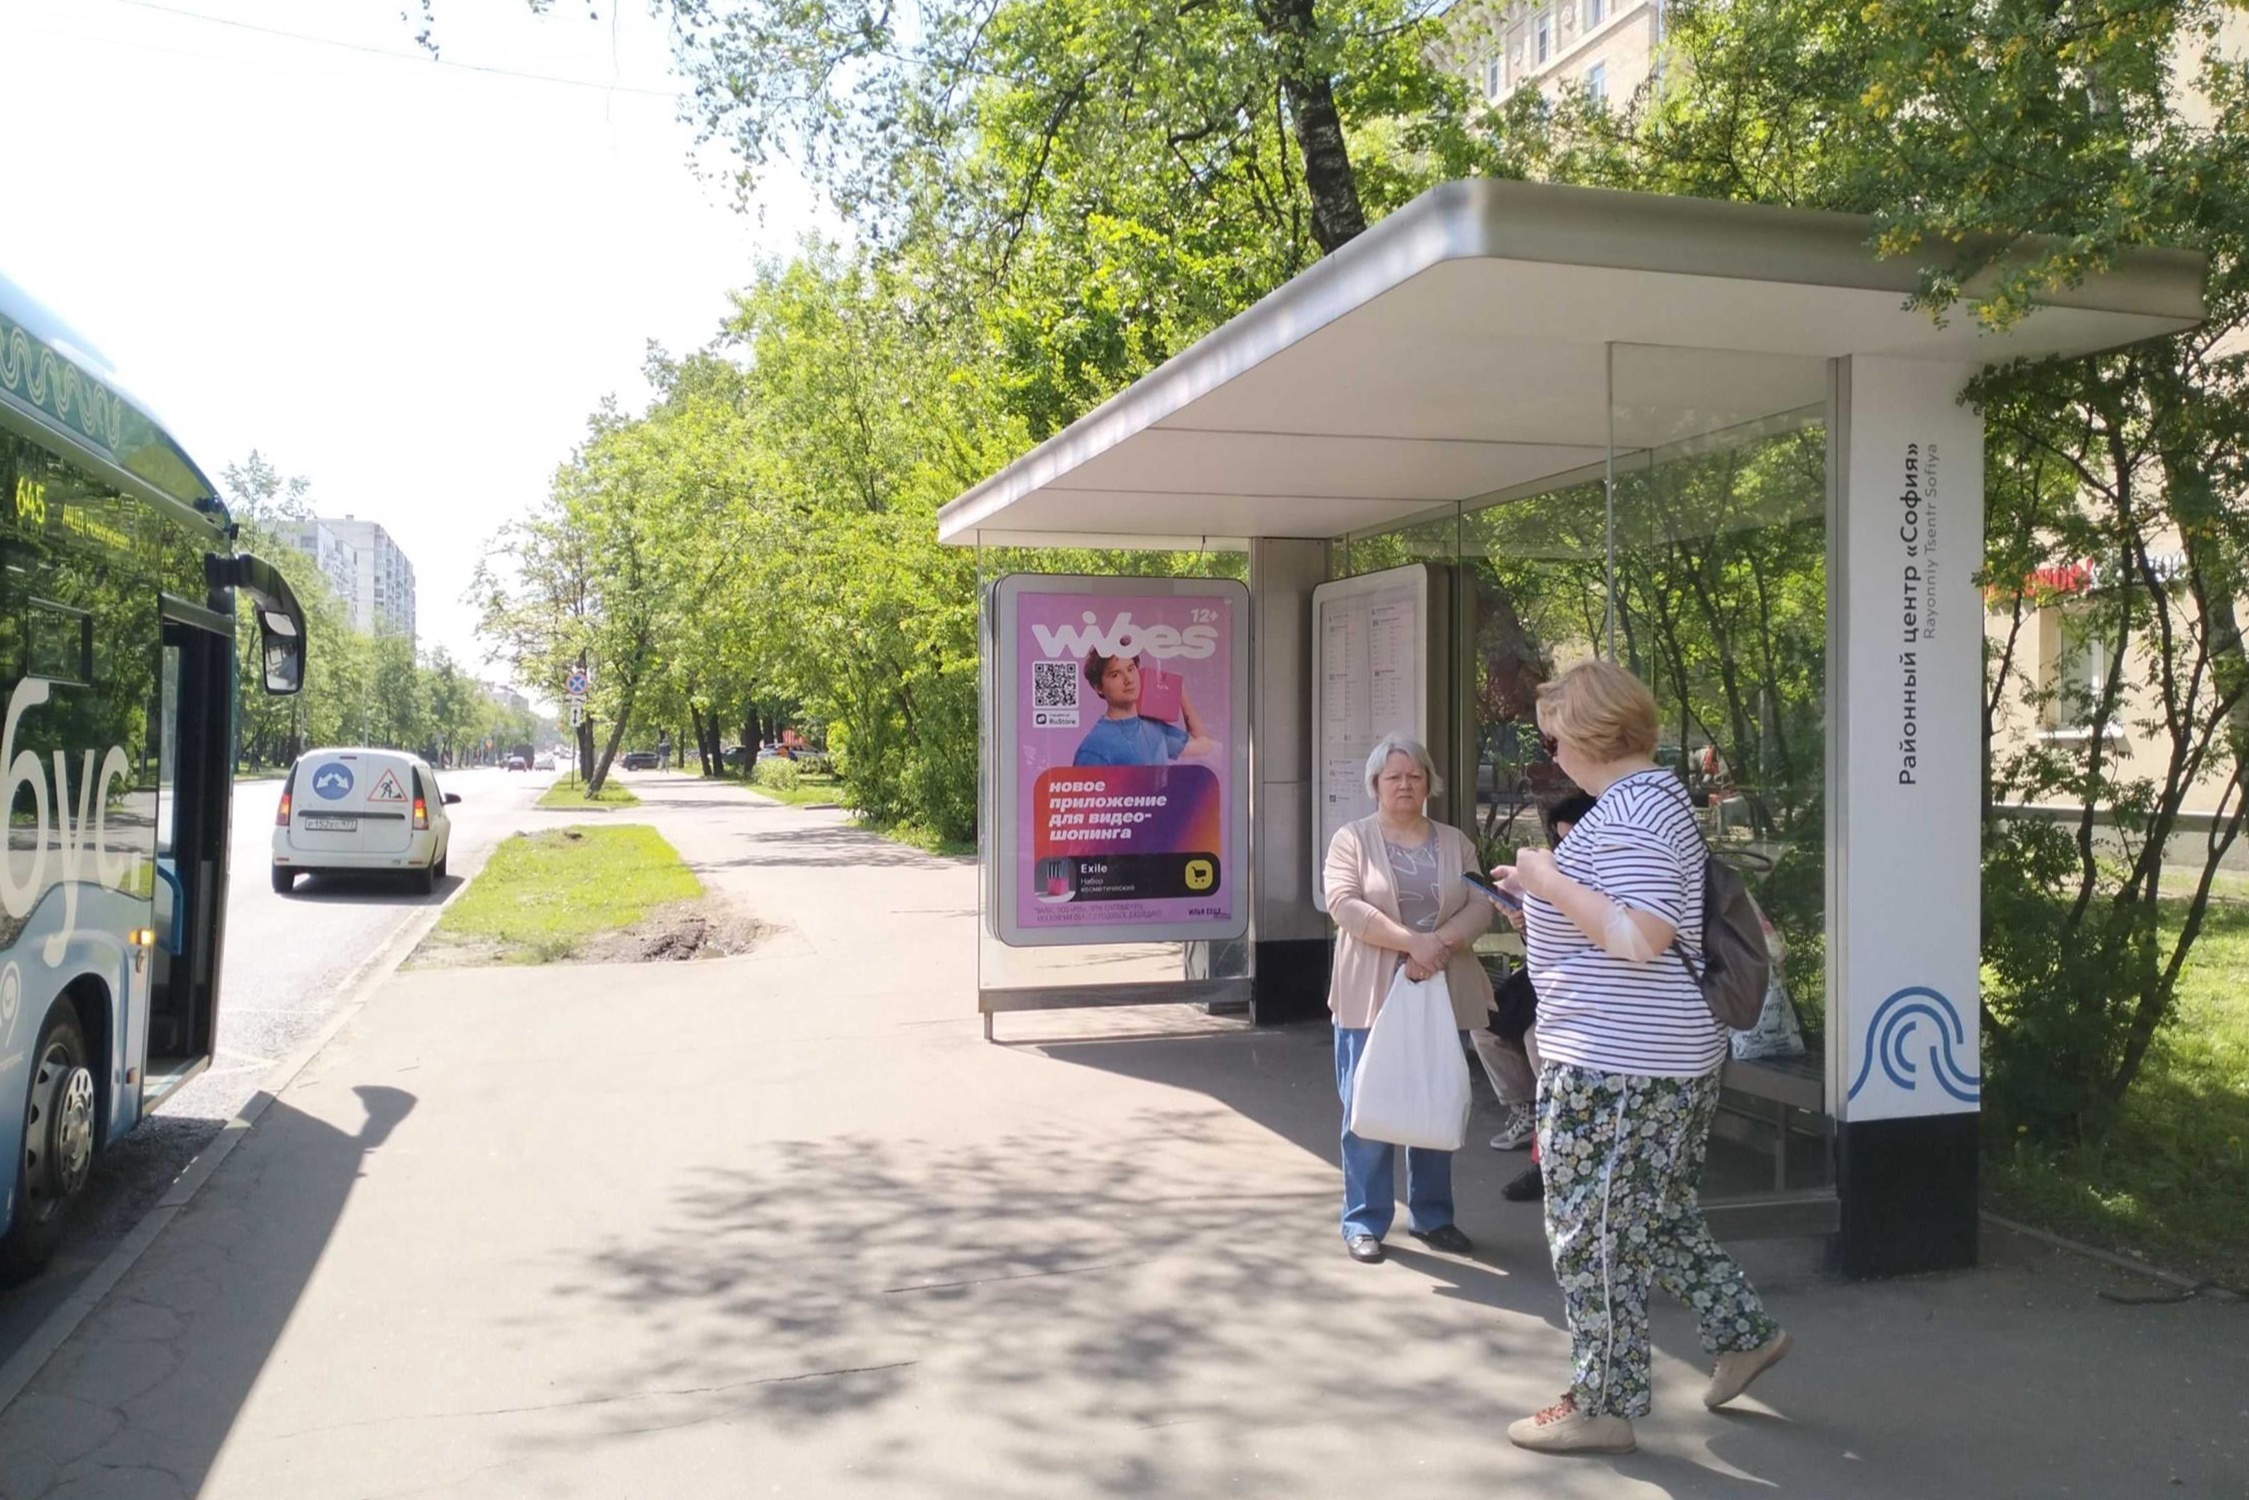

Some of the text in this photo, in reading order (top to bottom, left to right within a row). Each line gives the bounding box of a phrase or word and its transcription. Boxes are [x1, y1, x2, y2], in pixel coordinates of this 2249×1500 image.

[16, 475, 46, 524] 645
[1923, 443, 1940, 639] Rayonniy Tsentr Sofiya
[1190, 608, 1219, 623] 12+
[1899, 443, 1922, 785] Районный центр «София»
[1049, 781, 1106, 793] новое
[1049, 795, 1168, 813] приложение
[1049, 812, 1152, 828] для видео-
[1049, 828, 1132, 841] шопинга
[1080, 863, 1108, 874] Exile
[1080, 877, 1104, 886] Набор
